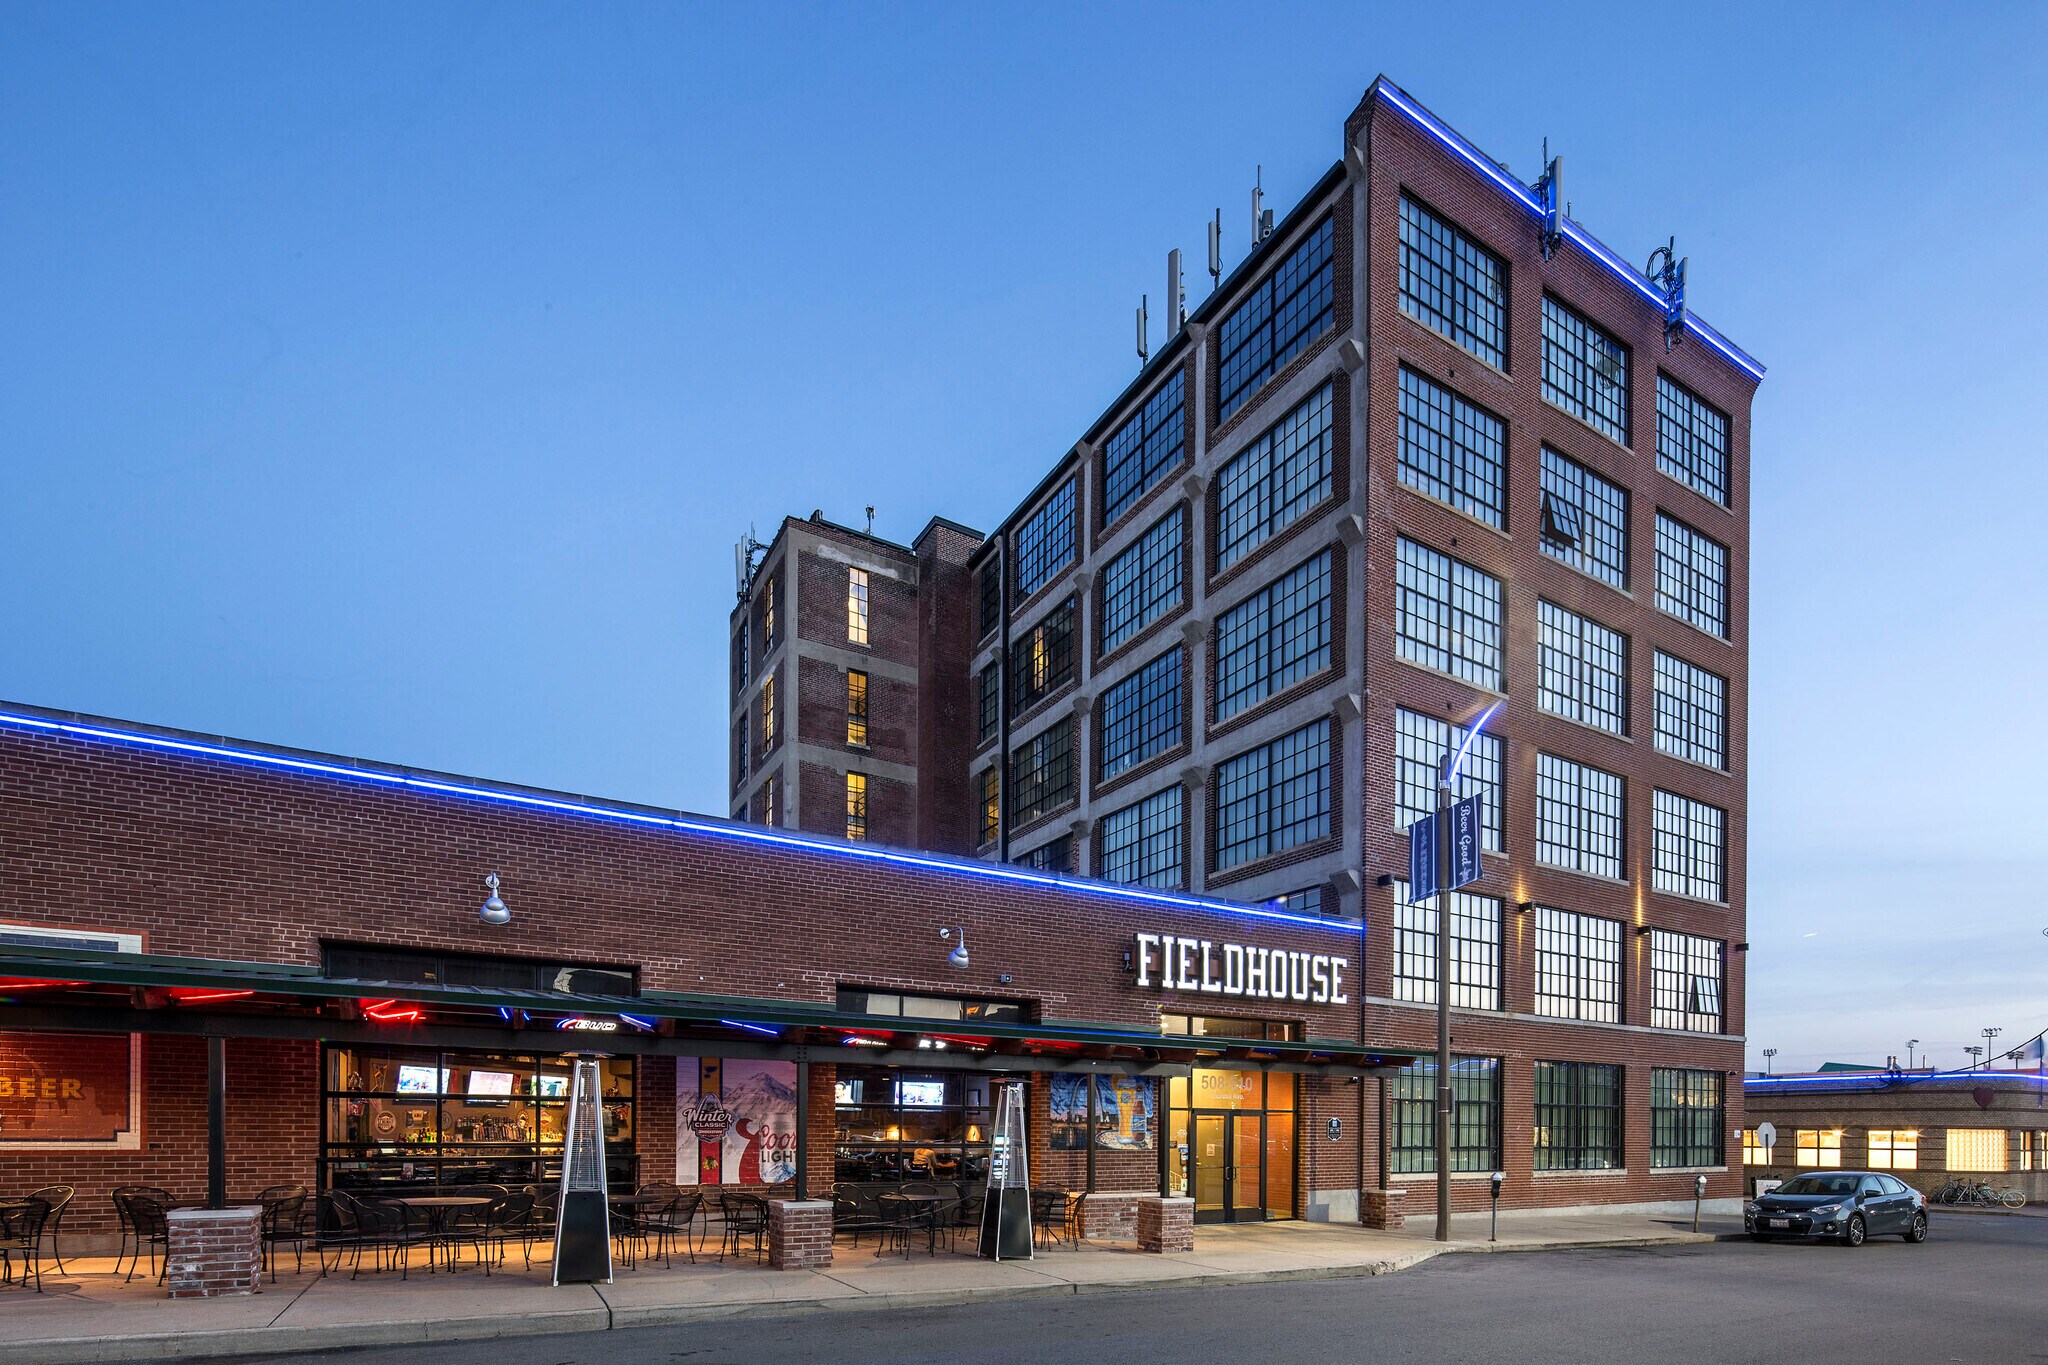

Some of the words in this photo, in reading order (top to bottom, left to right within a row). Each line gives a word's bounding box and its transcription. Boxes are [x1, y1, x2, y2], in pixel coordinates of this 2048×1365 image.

[1460, 805, 1471, 834] Beer
[1459, 835, 1472, 865] Good
[1136, 933, 1348, 1004] FIELDHOUSE
[0, 1076, 83, 1099] BEER
[683, 1108, 733, 1129] Winter
[759, 1124, 797, 1151] Coor
